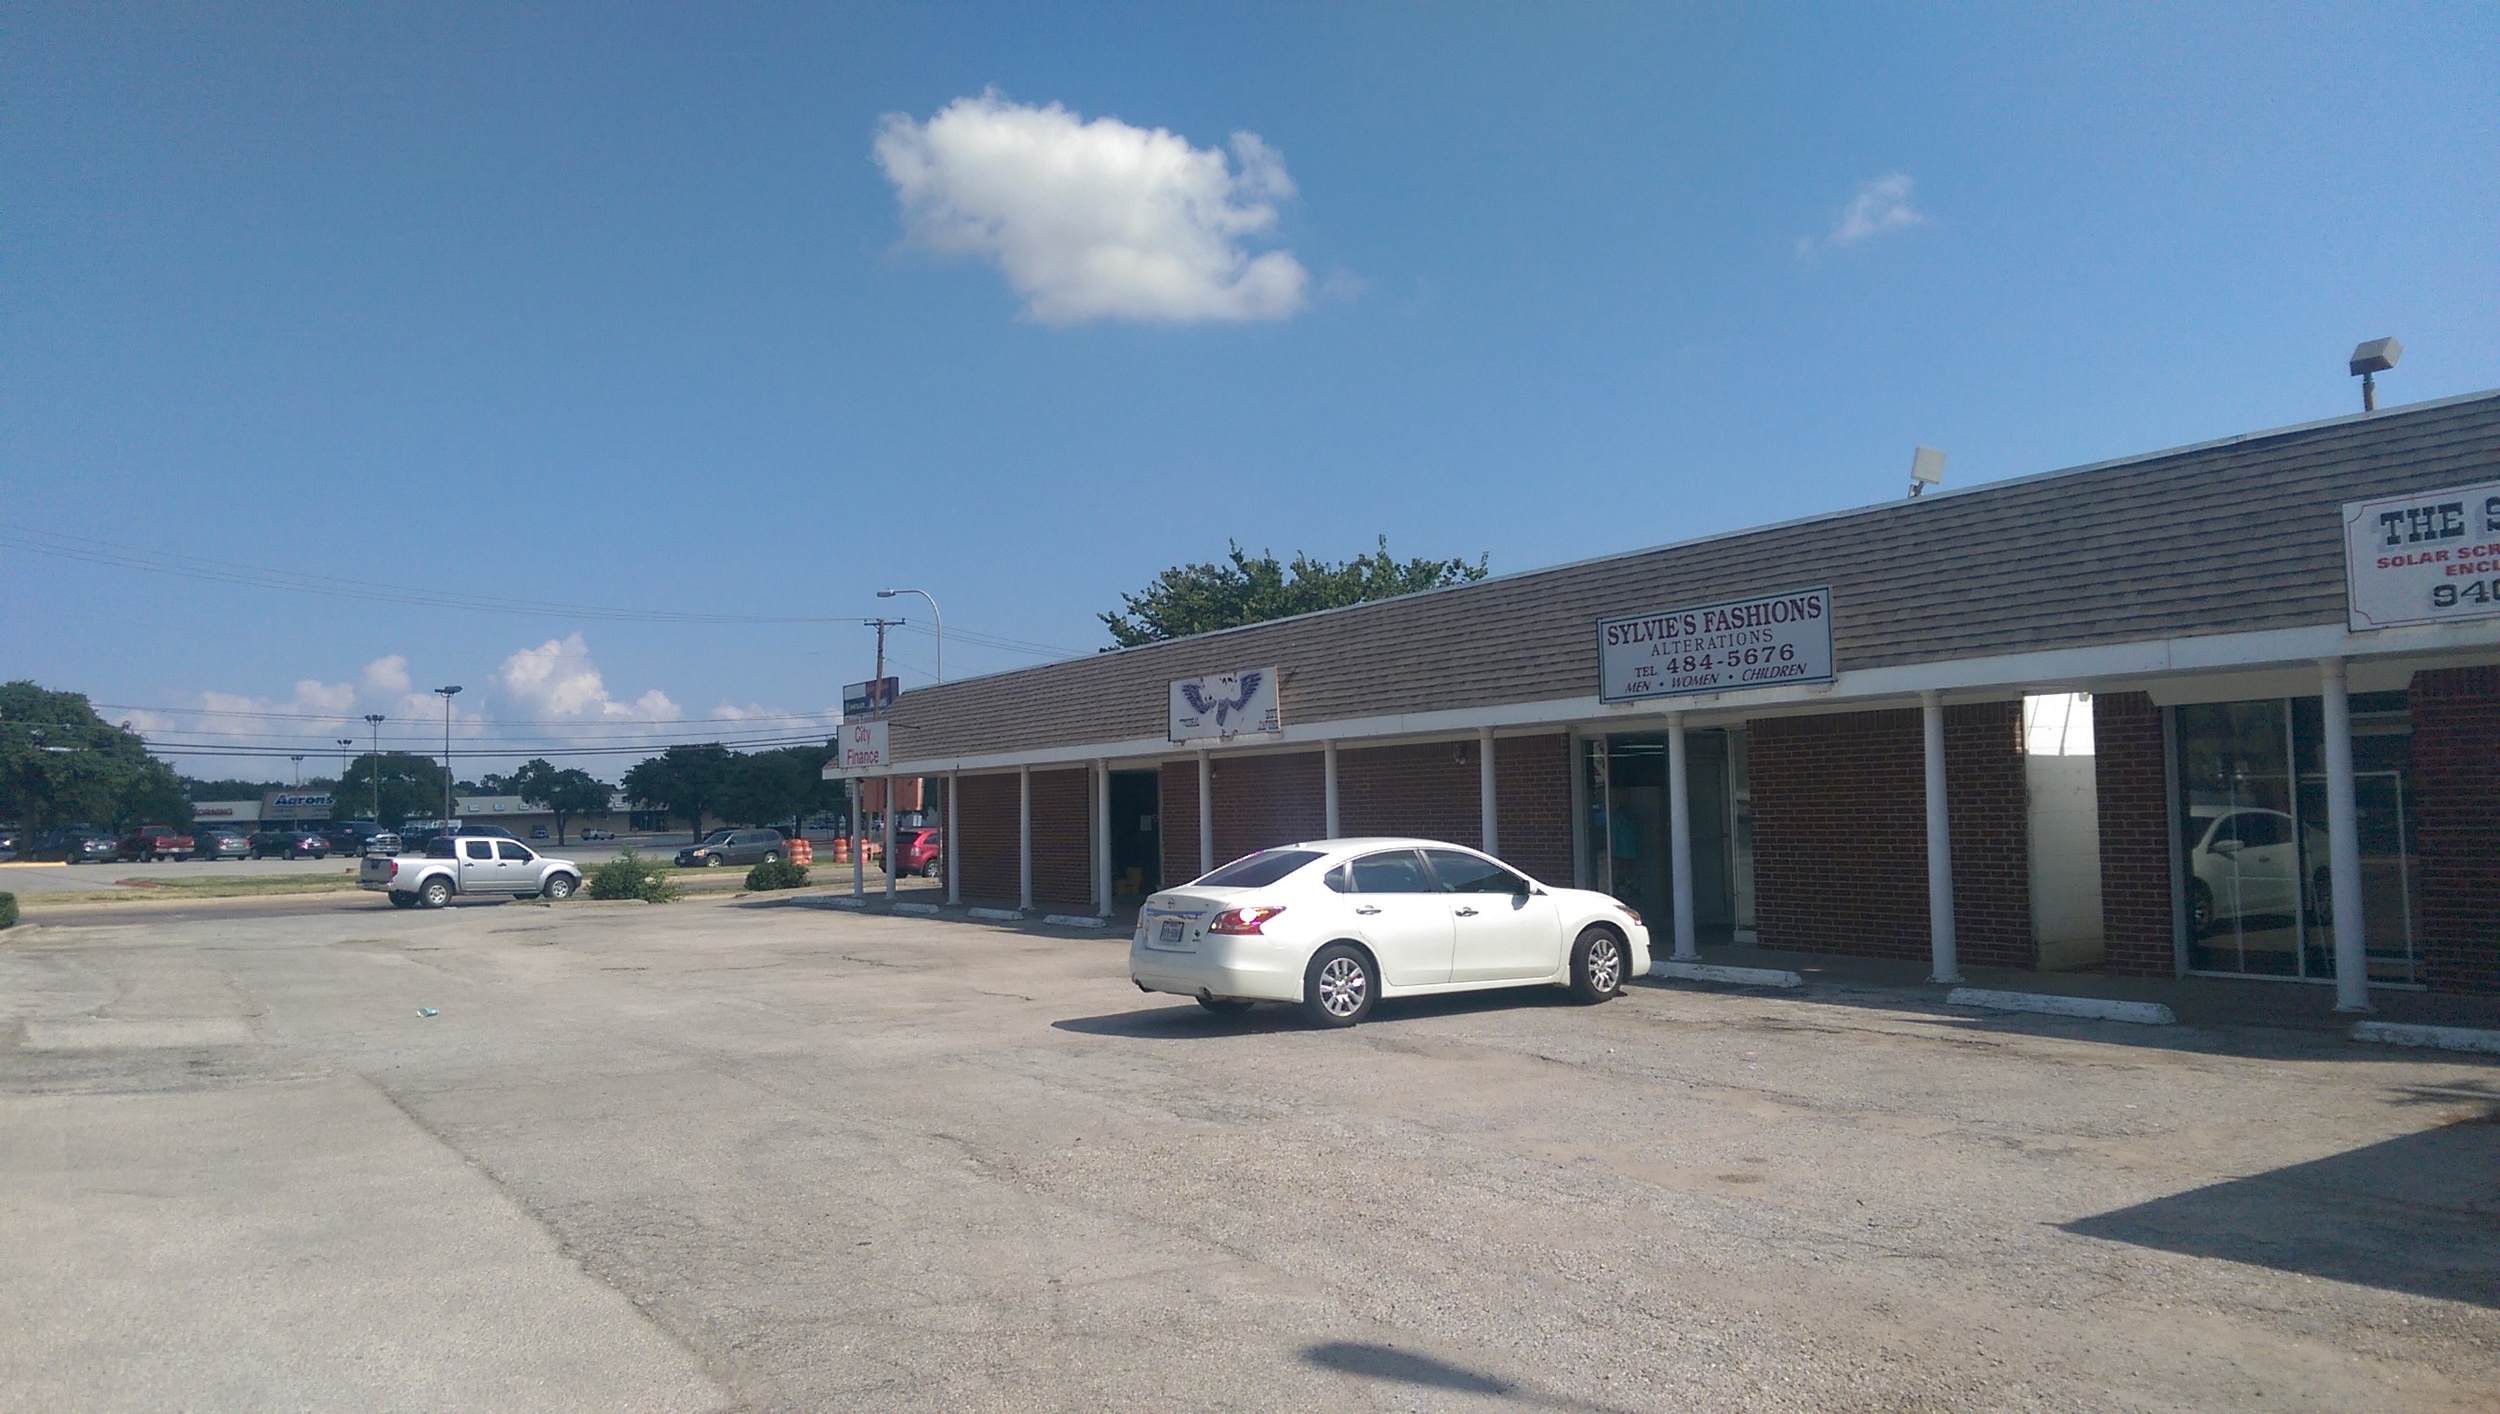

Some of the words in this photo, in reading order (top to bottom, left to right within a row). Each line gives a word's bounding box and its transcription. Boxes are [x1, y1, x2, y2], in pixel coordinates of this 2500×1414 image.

[2380, 502, 2465, 546] THE
[2377, 550, 2450, 569] SOLAR
[1607, 613, 1697, 646] SYLVIE'S
[1703, 595, 1822, 633] FASHIONS
[1651, 628, 1774, 657] ALTERATIONS
[1666, 643, 1795, 674] 484-5676
[1624, 681, 1651, 694] MEN
[1671, 673, 1719, 688] WOMEN
[1741, 663, 1807, 682] CHILDREN
[854, 725, 871, 745] City
[846, 748, 879, 765] Finance
[273, 792, 335, 806] Aaron's
